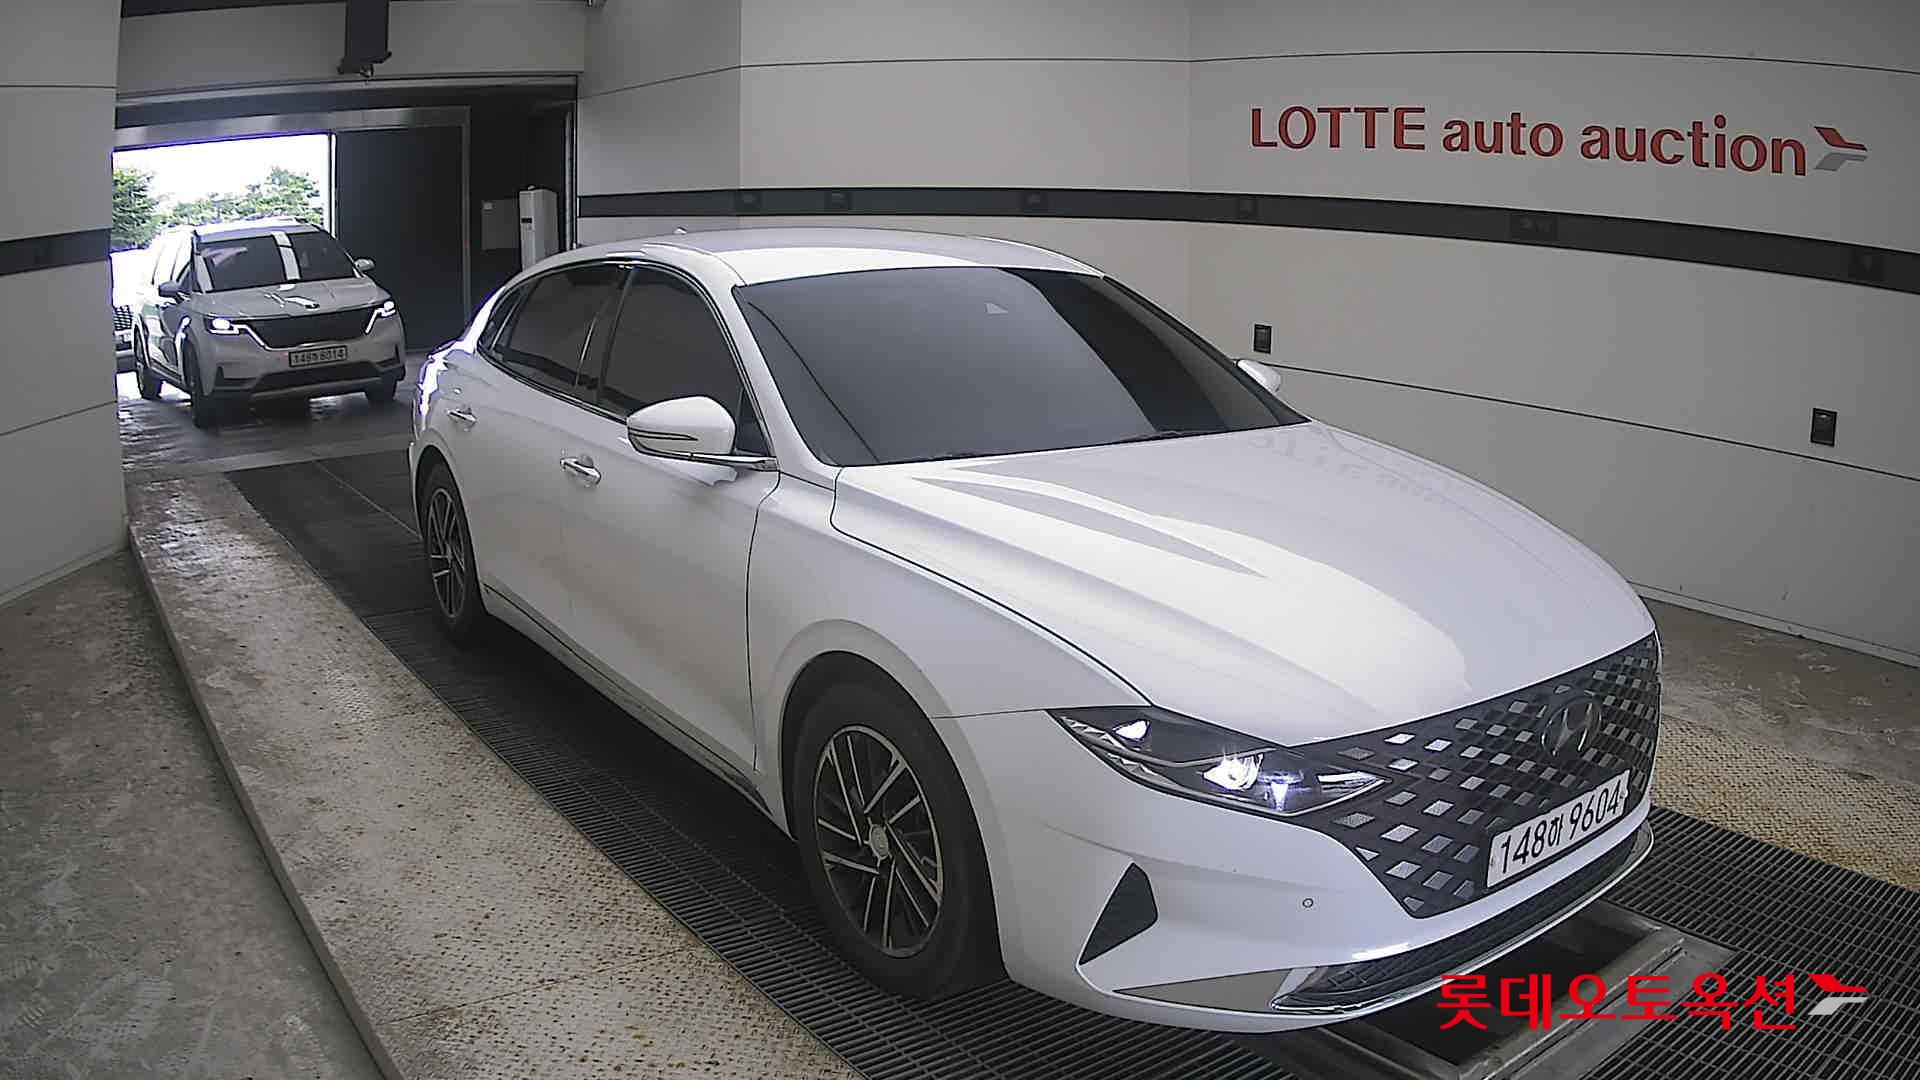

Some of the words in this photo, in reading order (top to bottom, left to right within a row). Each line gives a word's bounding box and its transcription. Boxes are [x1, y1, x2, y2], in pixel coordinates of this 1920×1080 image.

[1251, 106, 1426, 151] LOTTE
[1441, 112, 1564, 157] auto
[1580, 114, 1807, 176] auction
[1501, 814, 1564, 874] 148하
[1569, 779, 1622, 841] 9604
